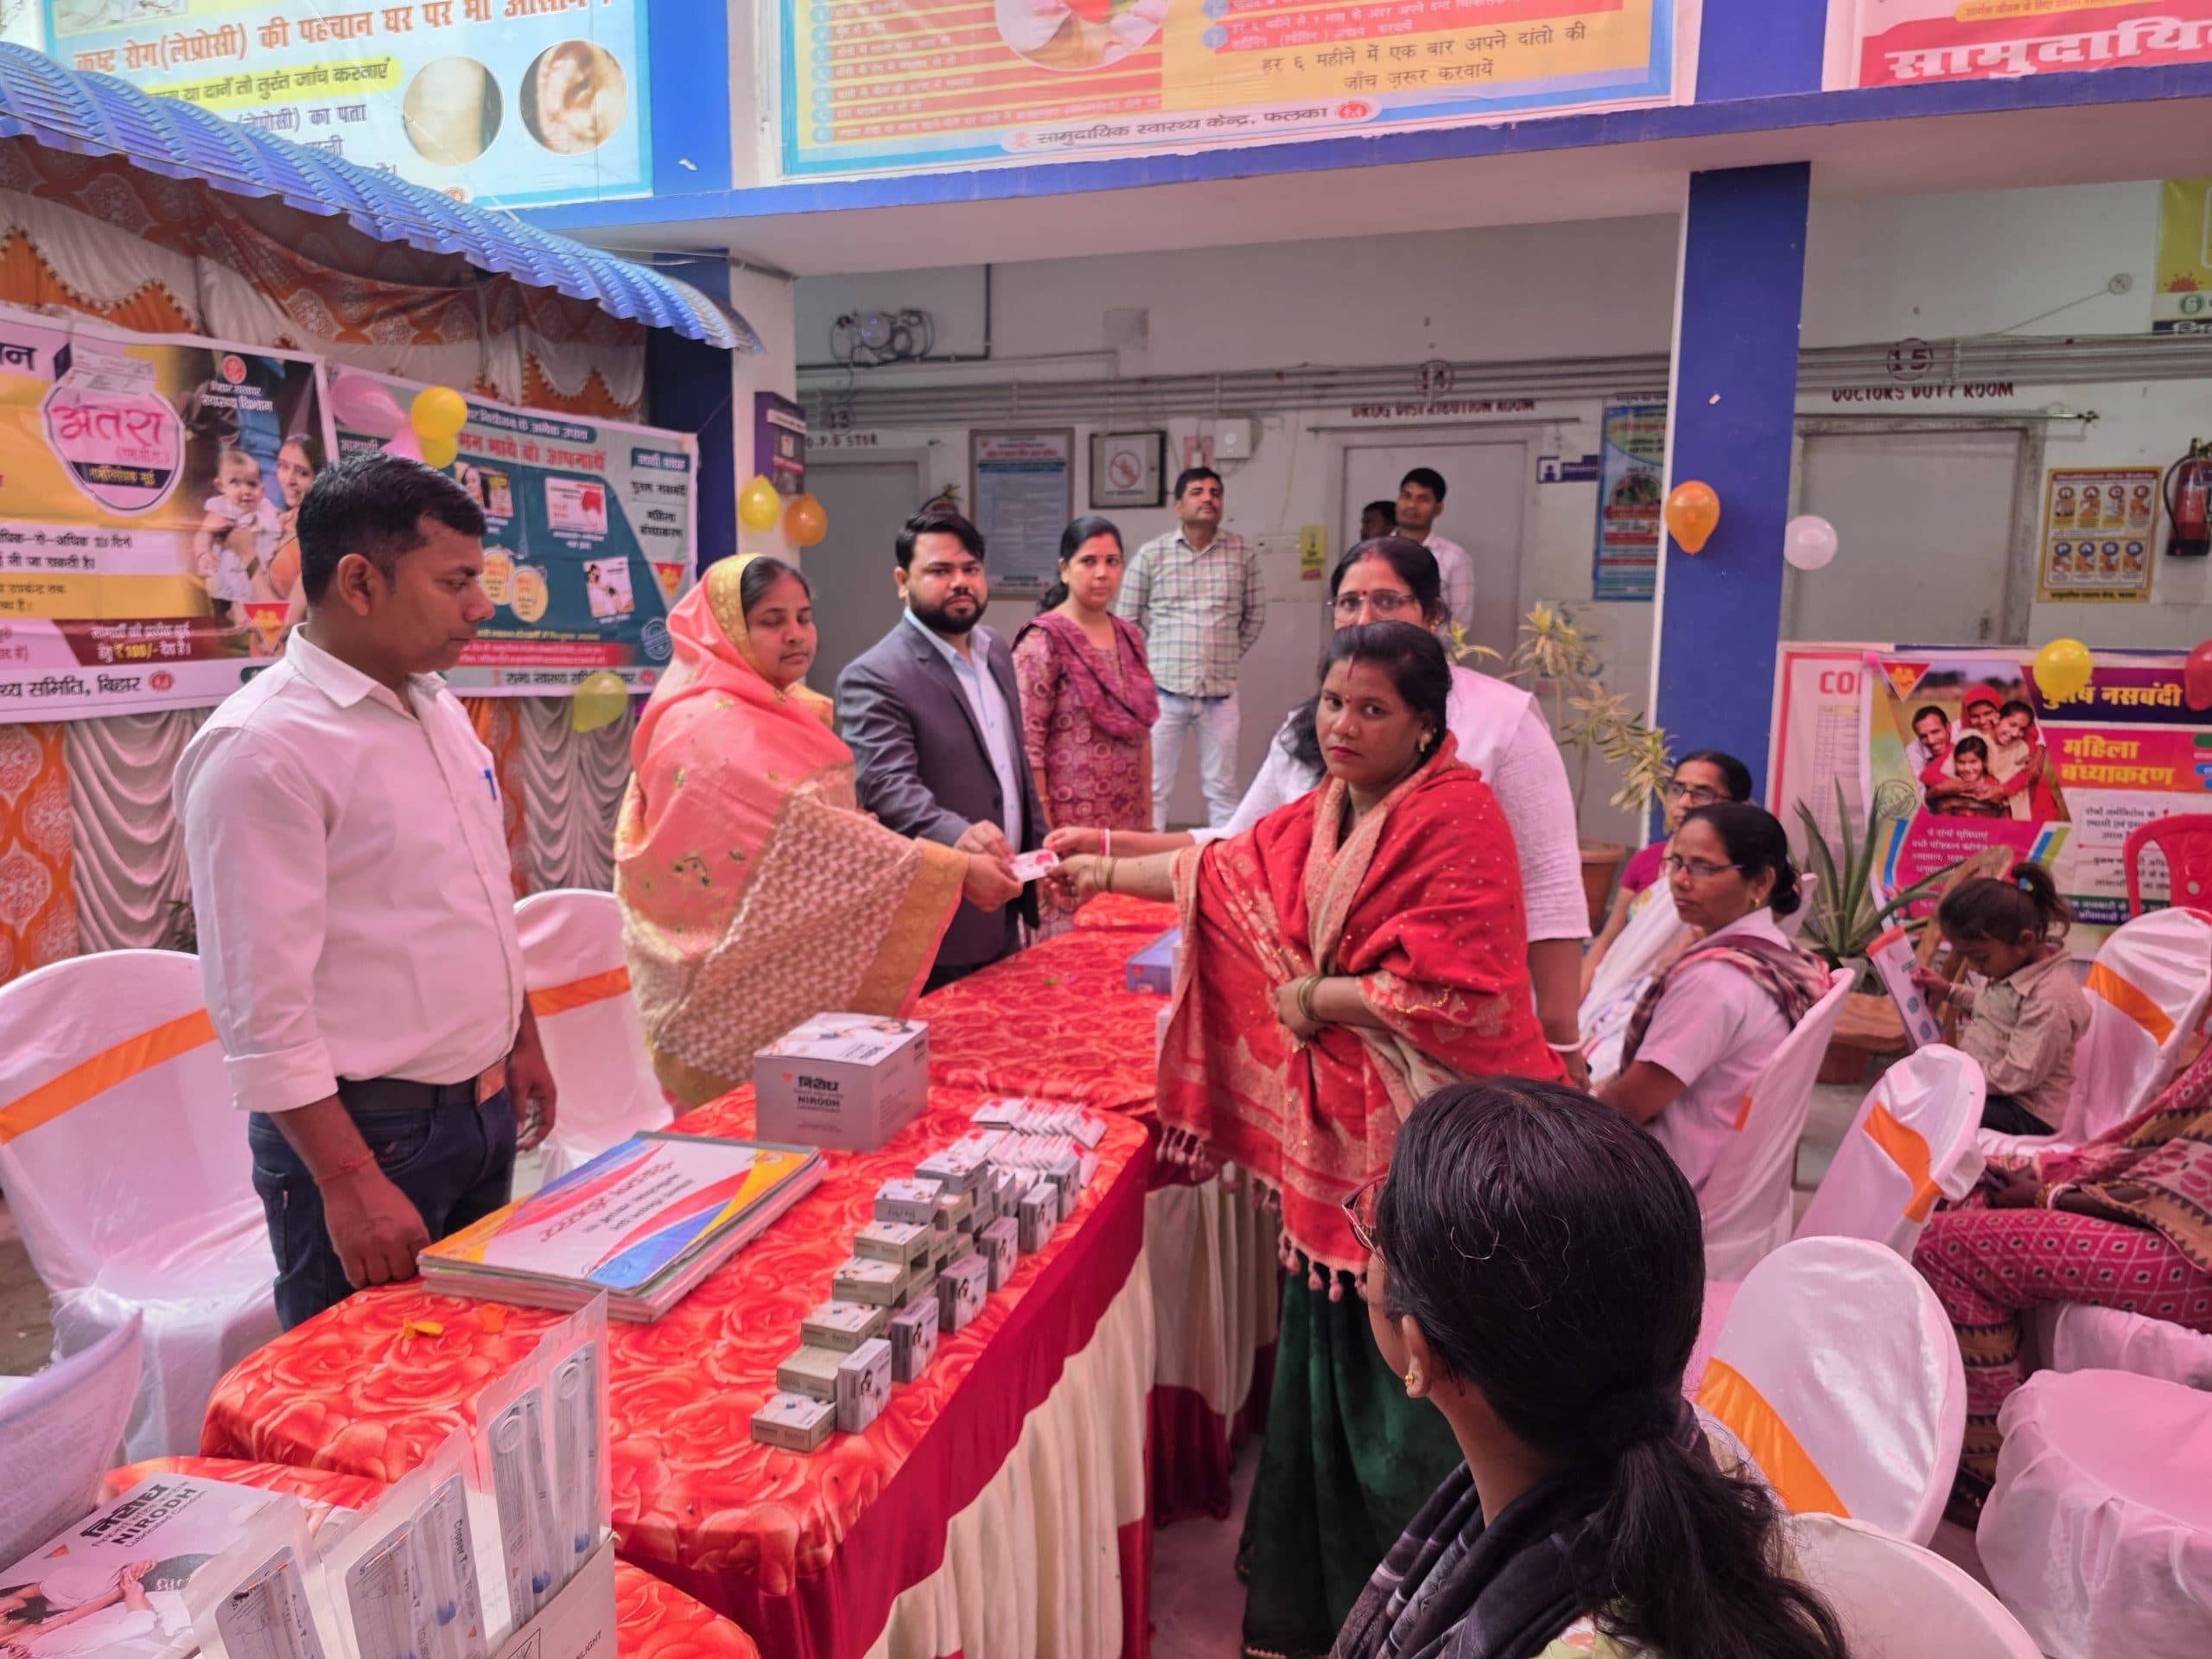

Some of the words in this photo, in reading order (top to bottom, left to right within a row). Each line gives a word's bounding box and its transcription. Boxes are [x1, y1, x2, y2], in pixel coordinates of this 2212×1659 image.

[257, 16, 291, 49] की
[297, 11, 374, 43] पहचान
[381, 6, 415, 33] घर
[423, 1, 453, 28] पर
[1262, 56, 1286, 74] हर
[1294, 54, 1306, 73] ६
[1315, 45, 1357, 69] महीने
[1366, 40, 1380, 62] में
[1389, 41, 1418, 60] एक
[1427, 41, 1455, 56] बार
[1465, 29, 1507, 52] अपने
[1517, 25, 1554, 46] दांतो
[1564, 20, 1586, 41] की
[1885, 16, 2212, 79] सामुदायि
[1438, 57, 1494, 81] करवायें
[308, 107, 331, 126] का
[336, 103, 367, 123] पता
[1038, 124, 1130, 147] सामुदायिक
[1137, 118, 1201, 136] स्वास्थ्य
[1263, 105, 1328, 124] फलका
[1963, 382, 2014, 399] ROOM
[97, 673, 141, 695] बिहार
[2100, 682, 2184, 708] नसबंदी
[2063, 734, 2141, 759] महिला
[2060, 758, 2177, 785] बंध्याकरण
[110, 1487, 198, 1546] NIRODH
